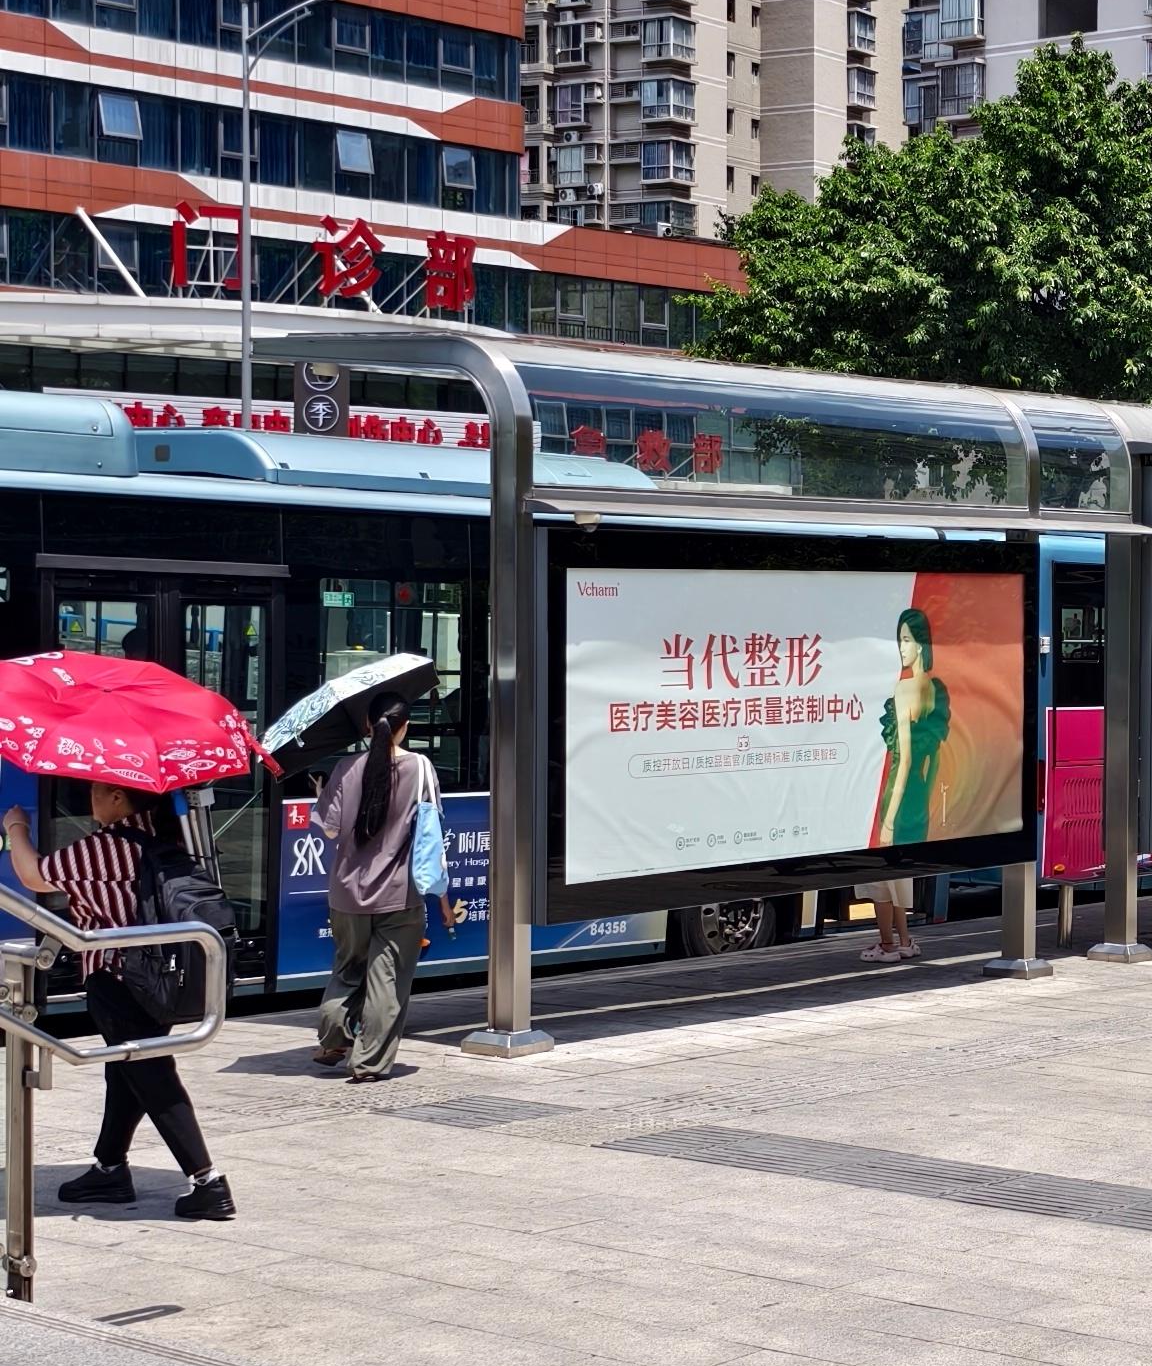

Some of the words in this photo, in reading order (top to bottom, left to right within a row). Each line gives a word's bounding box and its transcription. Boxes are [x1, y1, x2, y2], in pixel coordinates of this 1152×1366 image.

[171, 200, 477, 312] 门诊部
[577, 582, 619, 597] Vcharm
[660, 632, 823, 690] 当代整形
[610, 693, 864, 733] 医疗美容医疗质量控制中心
[590, 920, 627, 936] 84358
